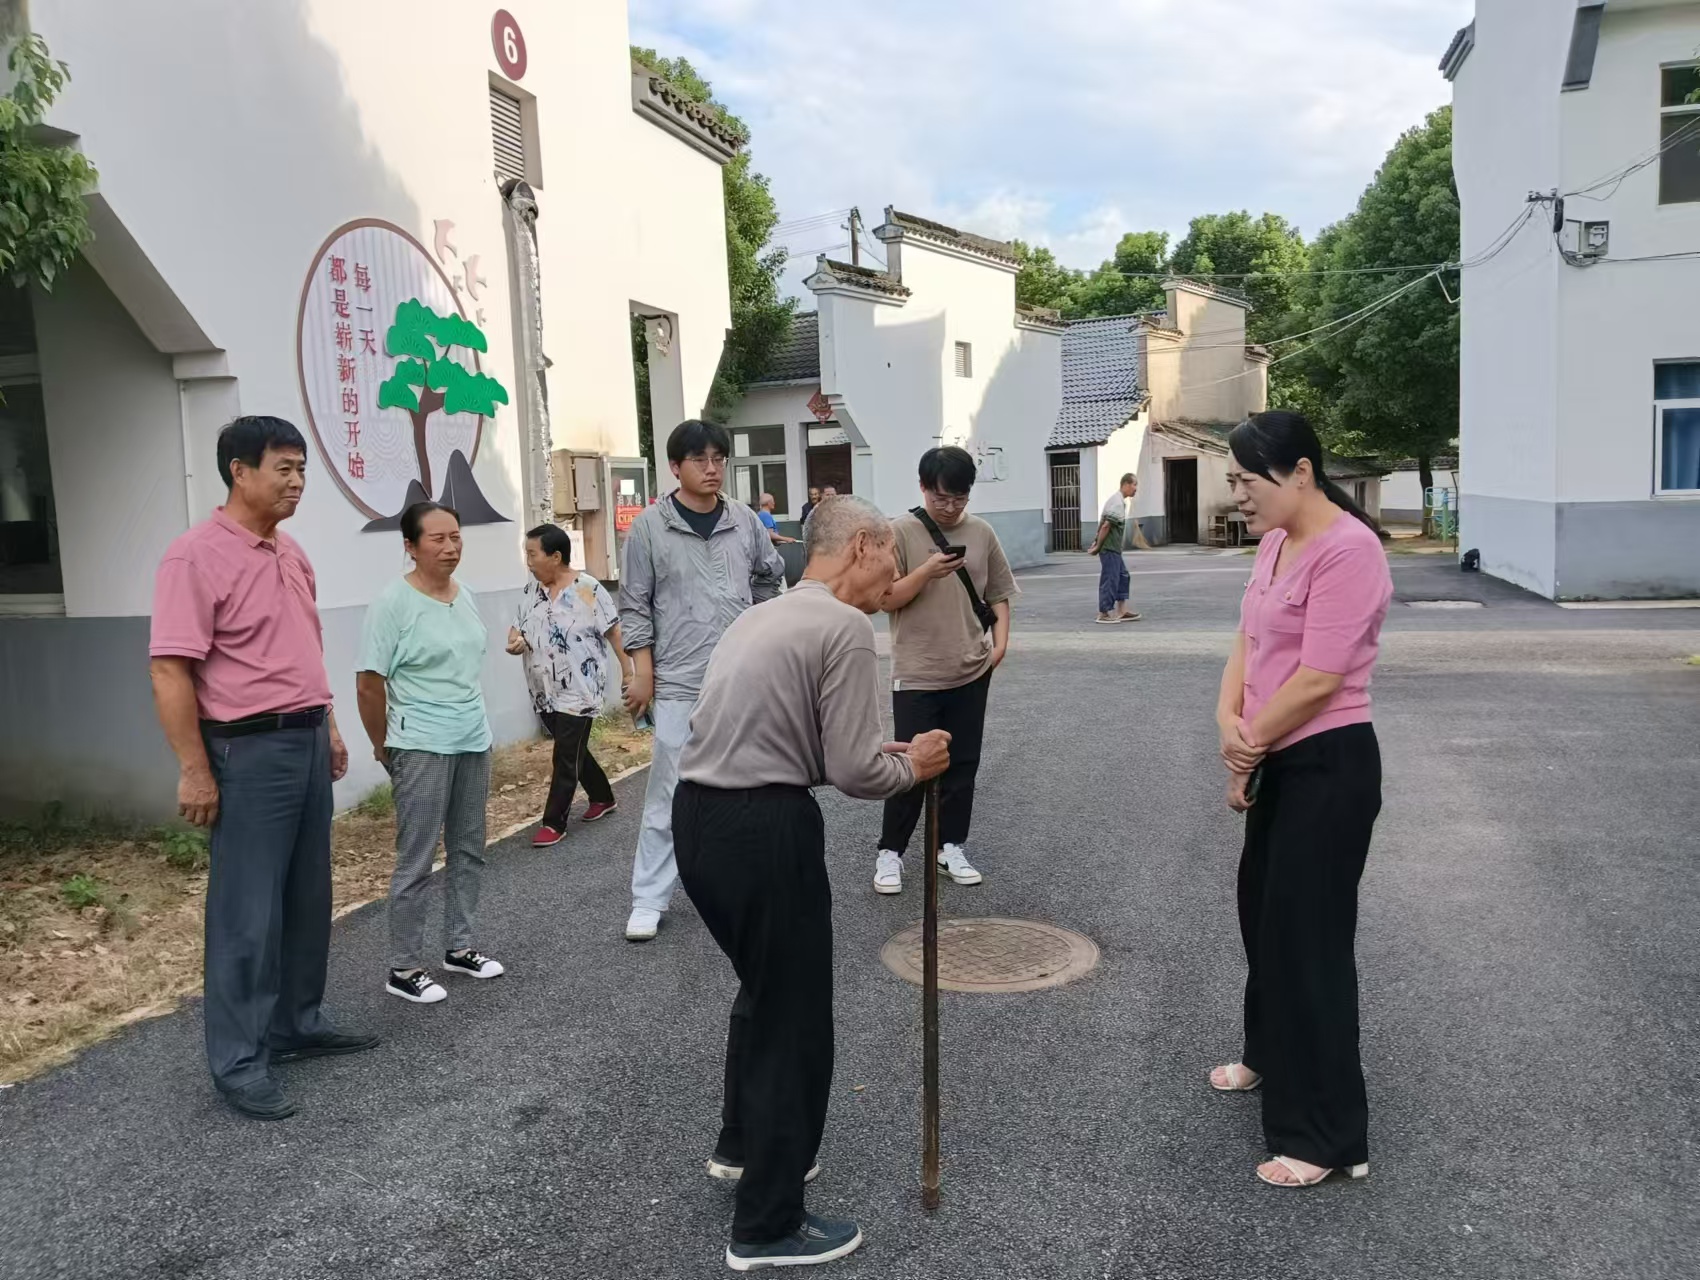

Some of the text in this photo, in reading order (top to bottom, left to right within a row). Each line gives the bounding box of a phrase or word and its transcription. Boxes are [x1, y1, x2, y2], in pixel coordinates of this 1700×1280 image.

[503, 26, 518, 64] 6
[355, 262, 376, 356] 每一天
[328, 254, 365, 480] 都是崭新的开始
